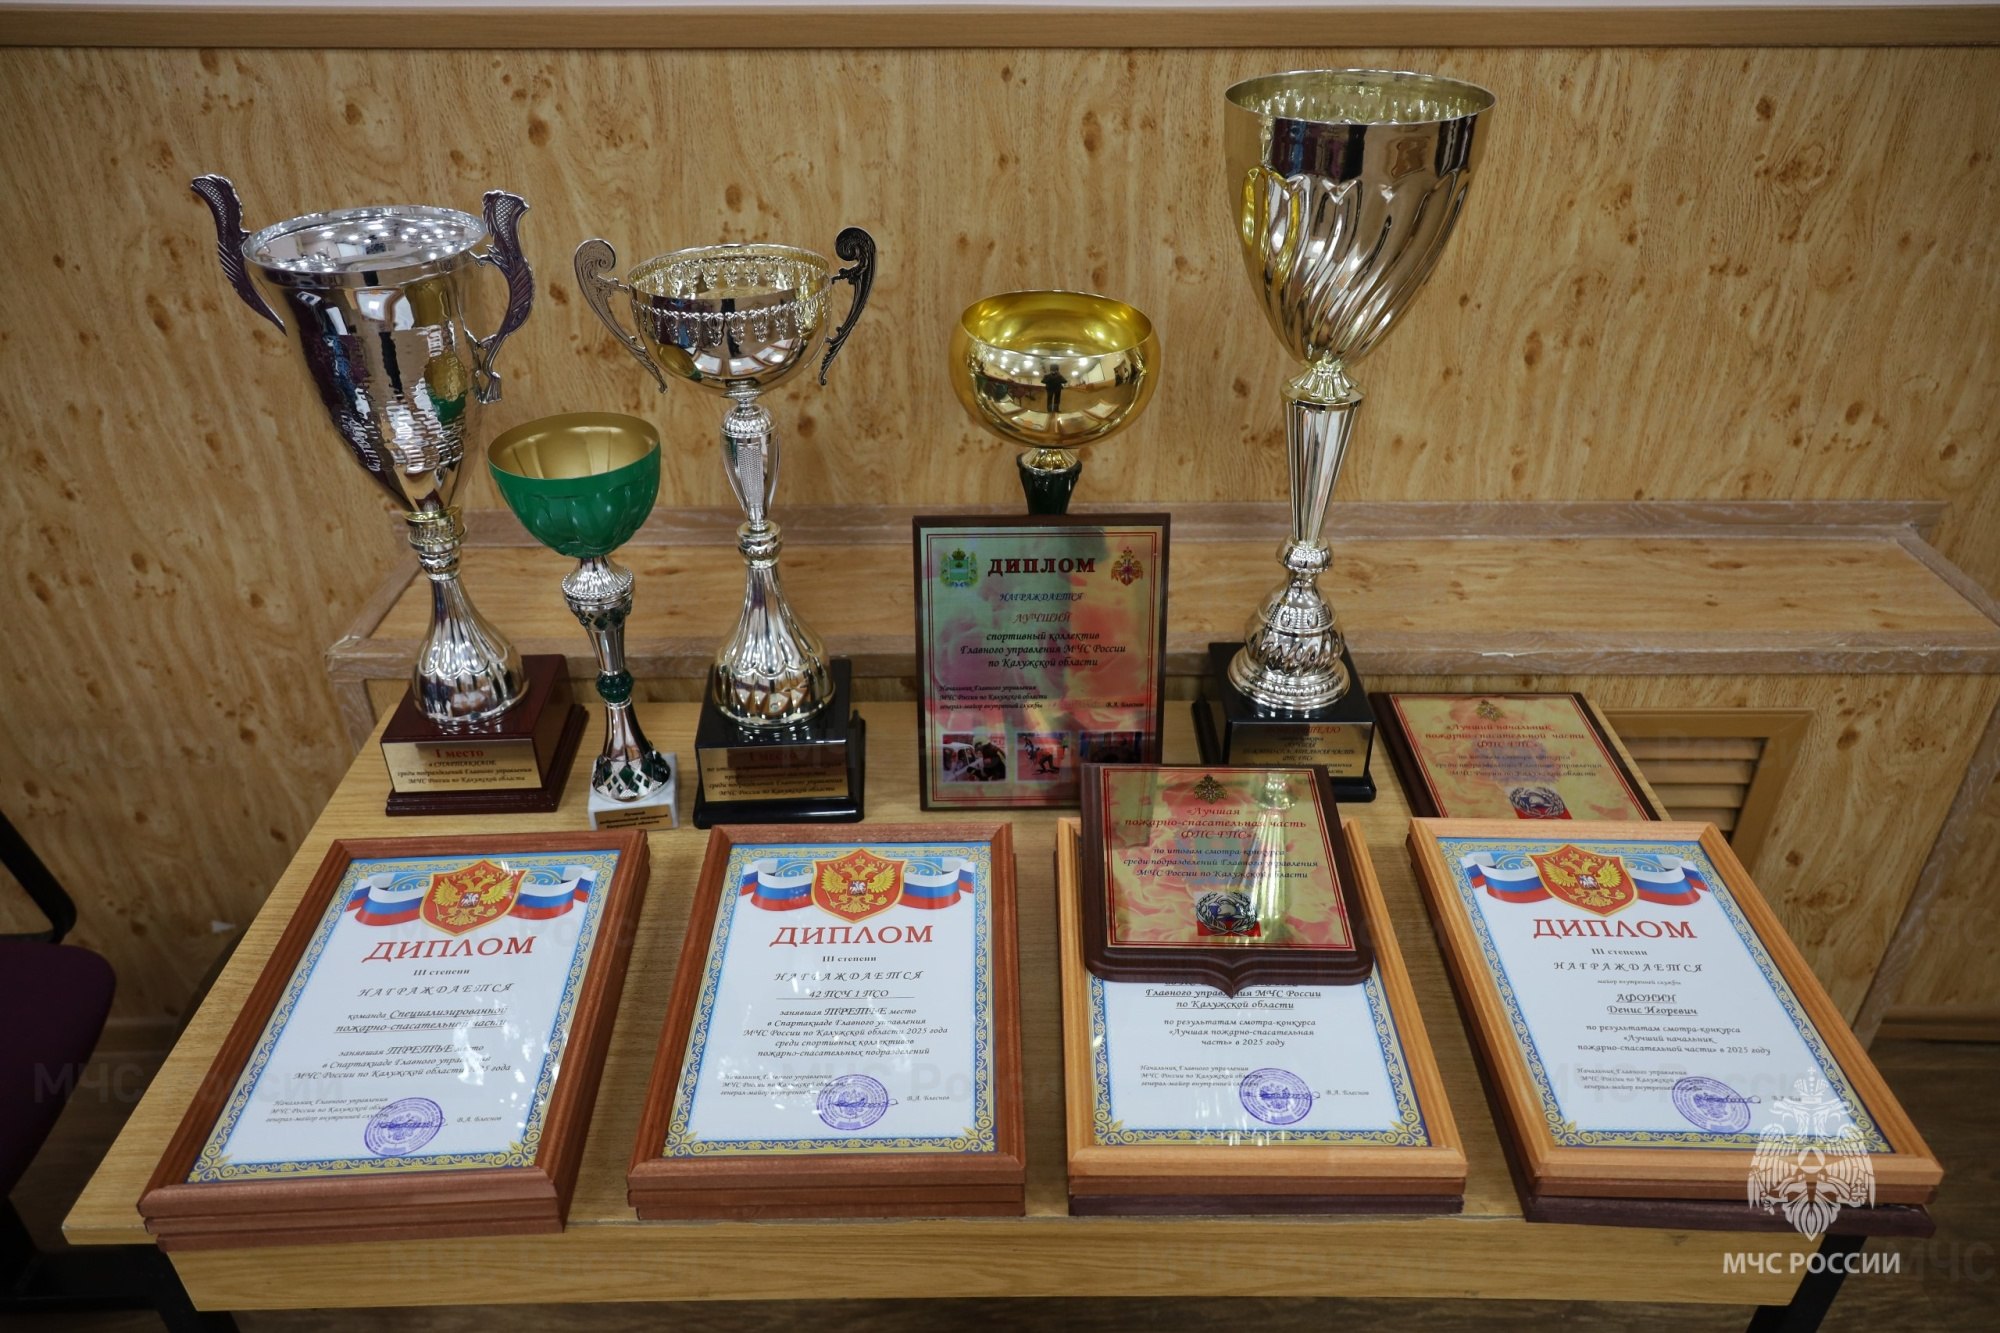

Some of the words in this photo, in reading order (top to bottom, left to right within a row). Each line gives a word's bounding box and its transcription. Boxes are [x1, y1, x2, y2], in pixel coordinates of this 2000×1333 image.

[988, 558, 1095, 576] ДИПЛОМ
[1000, 593, 1084, 602] НАГРАЖДАЕТСЯ
[1013, 612, 1071, 623] ЛУЧШИЙ
[986, 632, 1046, 642] спортивный
[960, 646, 1004, 654] Главного
[1006, 646, 1062, 656] управления
[1064, 645, 1091, 653] МЧС
[1093, 645, 1126, 653] России
[1001, 658, 1055, 669] Калужской
[1058, 657, 1098, 667] области
[446, 750, 484, 758] место
[1186, 808, 1240, 816] «Лучшая
[1125, 819, 1264, 828] пожарно-спасательная
[1270, 820, 1306, 828] часть
[1123, 859, 1149, 867] среди
[1152, 858, 1218, 867] подразделений
[1214, 870, 1266, 879] Калужской
[1533, 919, 1698, 939] ДИПЛОМ
[769, 925, 933, 947] ДИПЛОМ
[361, 936, 537, 963] ДИПЛОМ
[1554, 962, 1703, 972] НАГРАЖДАЕТСЯ
[774, 971, 924, 982] НАГРАЖДАЕТСЯ
[357, 982, 516, 997] НАГРАЖДАЕТСЯ
[809, 990, 822, 998] 42
[823, 989, 855, 998] ПСЧ
[863, 989, 889, 998] ПСО
[1145, 989, 1192, 998] Главного
[1194, 989, 1252, 998] управия
[1255, 989, 1283, 998] МЧС
[1286, 989, 1321, 997] России
[1616, 994, 1676, 1003] АФОНИН
[1190, 1000, 1248, 1009] Калужской
[1252, 1000, 1294, 1009] области
[389, 1007, 508, 1020] Специализированной
[1607, 1006, 1643, 1014] Денис
[1644, 1006, 1698, 1016] Игоревич
[774, 1020, 833, 1028] Спартакиаде
[1177, 1019, 1237, 1027] результатам
[1239, 1019, 1316, 1028] смотра-конкурса
[816, 1029, 865, 1037] Калужской
[929, 1027, 948, 1035] года
[1663, 1025, 1741, 1034] смотра-конкурса
[775, 1040, 800, 1048] среди
[1623, 1035, 1664, 1043] «Лучший
[339, 1049, 384, 1057] занявшая
[386, 1044, 453, 1053] ТРЕТЬЕ
[757, 1050, 863, 1058] пожарно-спасательных
[1578, 1044, 1683, 1052] пожарно-спасательной
[1751, 1047, 1771, 1055] году
[330, 1059, 393, 1070] Спартакиаде
[394, 1058, 436, 1067] Главного
[323, 1071, 355, 1079] России
[372, 1067, 424, 1078] Калужской
[426, 1067, 463, 1075] области
[491, 1064, 511, 1072] года
